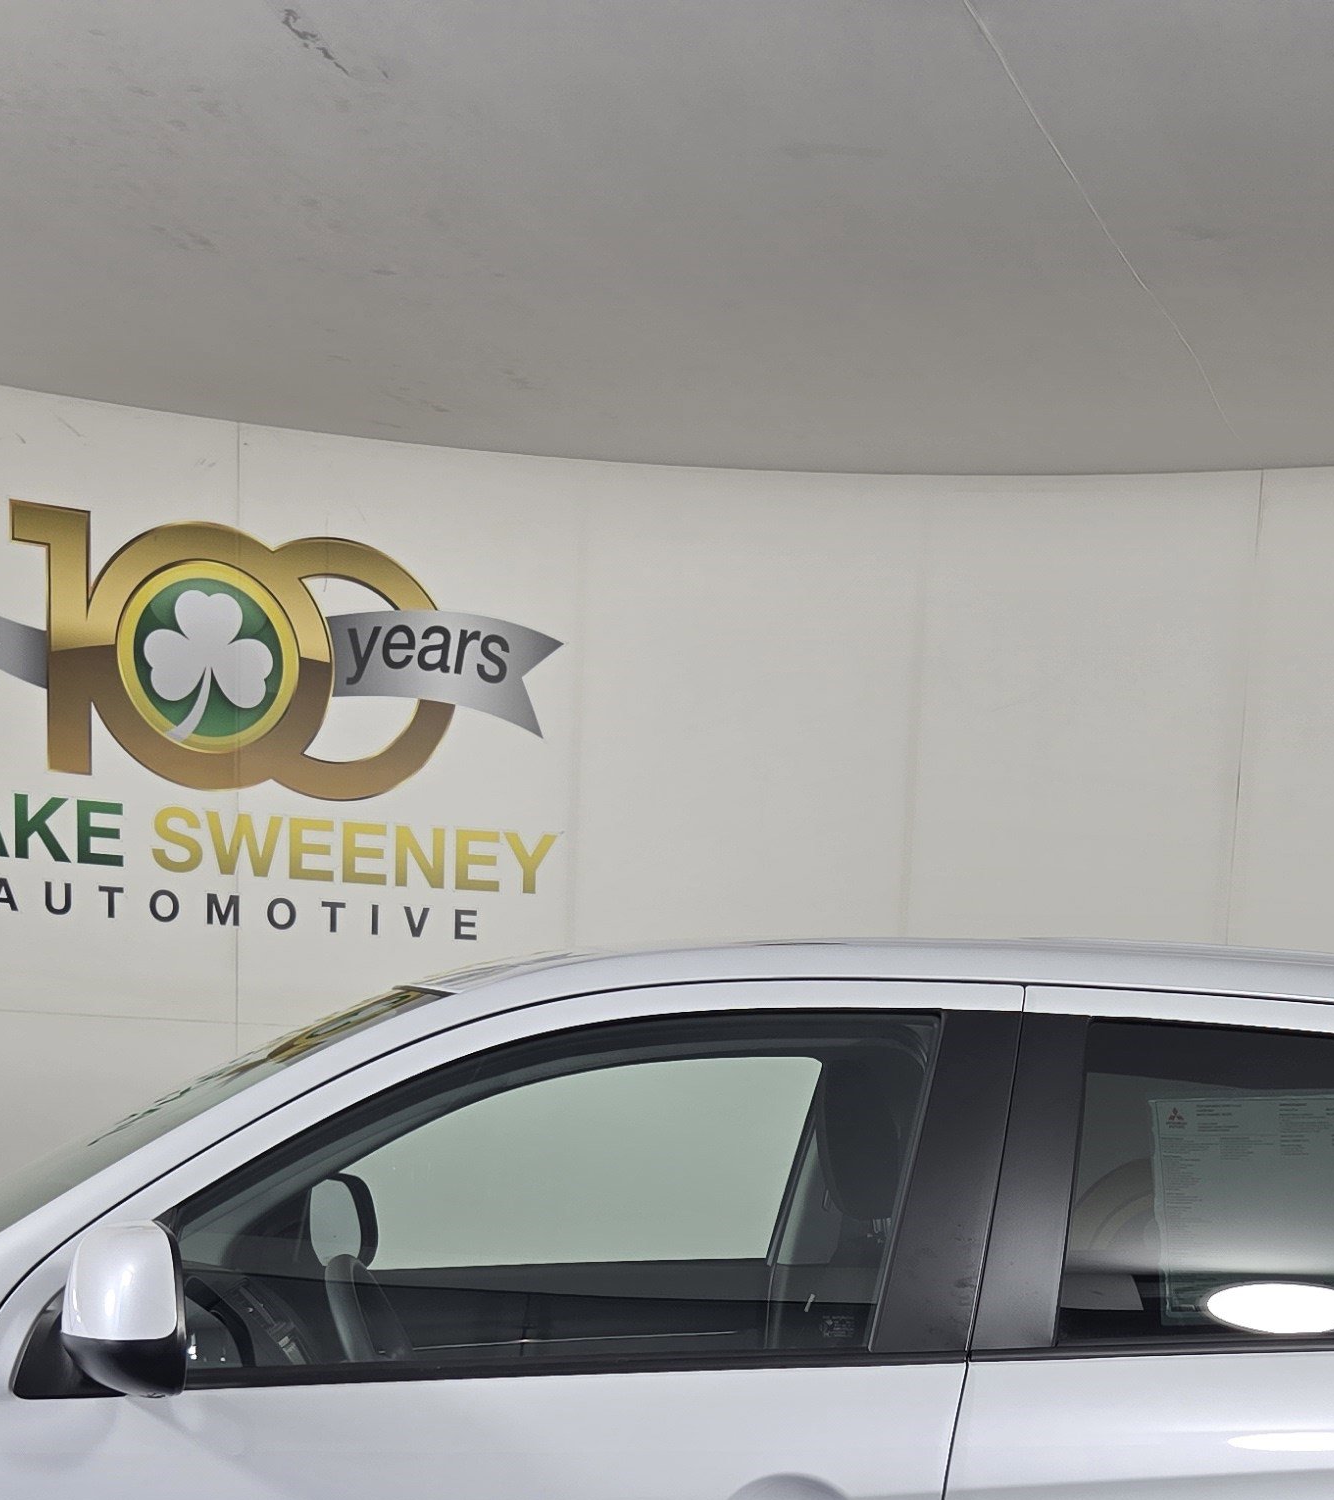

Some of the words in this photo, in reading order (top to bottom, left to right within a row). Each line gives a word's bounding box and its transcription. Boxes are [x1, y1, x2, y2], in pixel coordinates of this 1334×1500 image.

[9, 498, 455, 802] 100
[346, 624, 510, 686] years
[152, 804, 556, 895] SWEENEY
